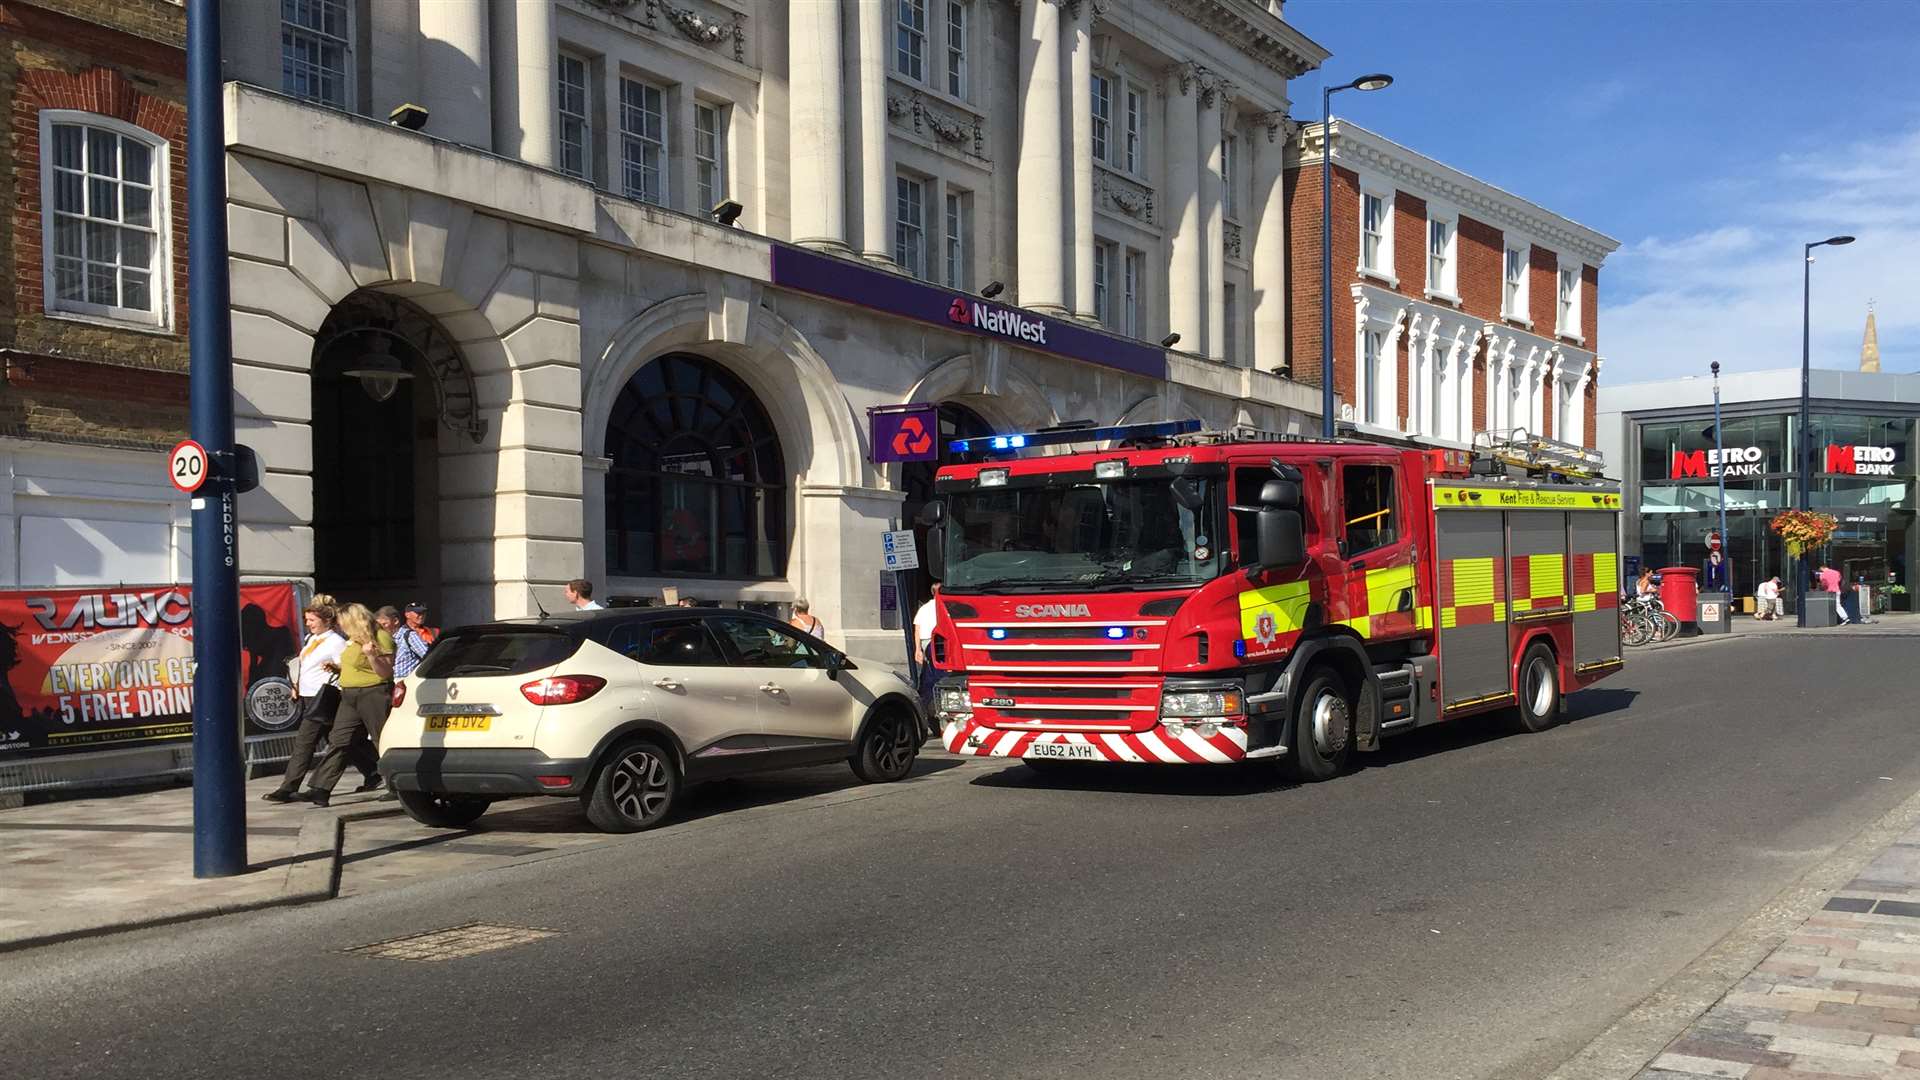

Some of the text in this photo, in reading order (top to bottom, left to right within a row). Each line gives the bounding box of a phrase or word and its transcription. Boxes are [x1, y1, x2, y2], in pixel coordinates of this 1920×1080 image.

[974, 302, 1046, 344] NatWest
[176, 456, 200, 476] 20
[1672, 446, 1762, 479] METRO
[1824, 444, 1895, 476] METRO
[1856, 463, 1895, 475] BANK
[1500, 492, 1516, 504] Kent
[26, 592, 193, 630] RAUNC
[1016, 604, 1091, 618] SCANIA
[50, 656, 194, 694] EVERYONE GE
[60, 686, 193, 724] 5 FREE DRIN
[1034, 744, 1092, 757] EU62 AYH
